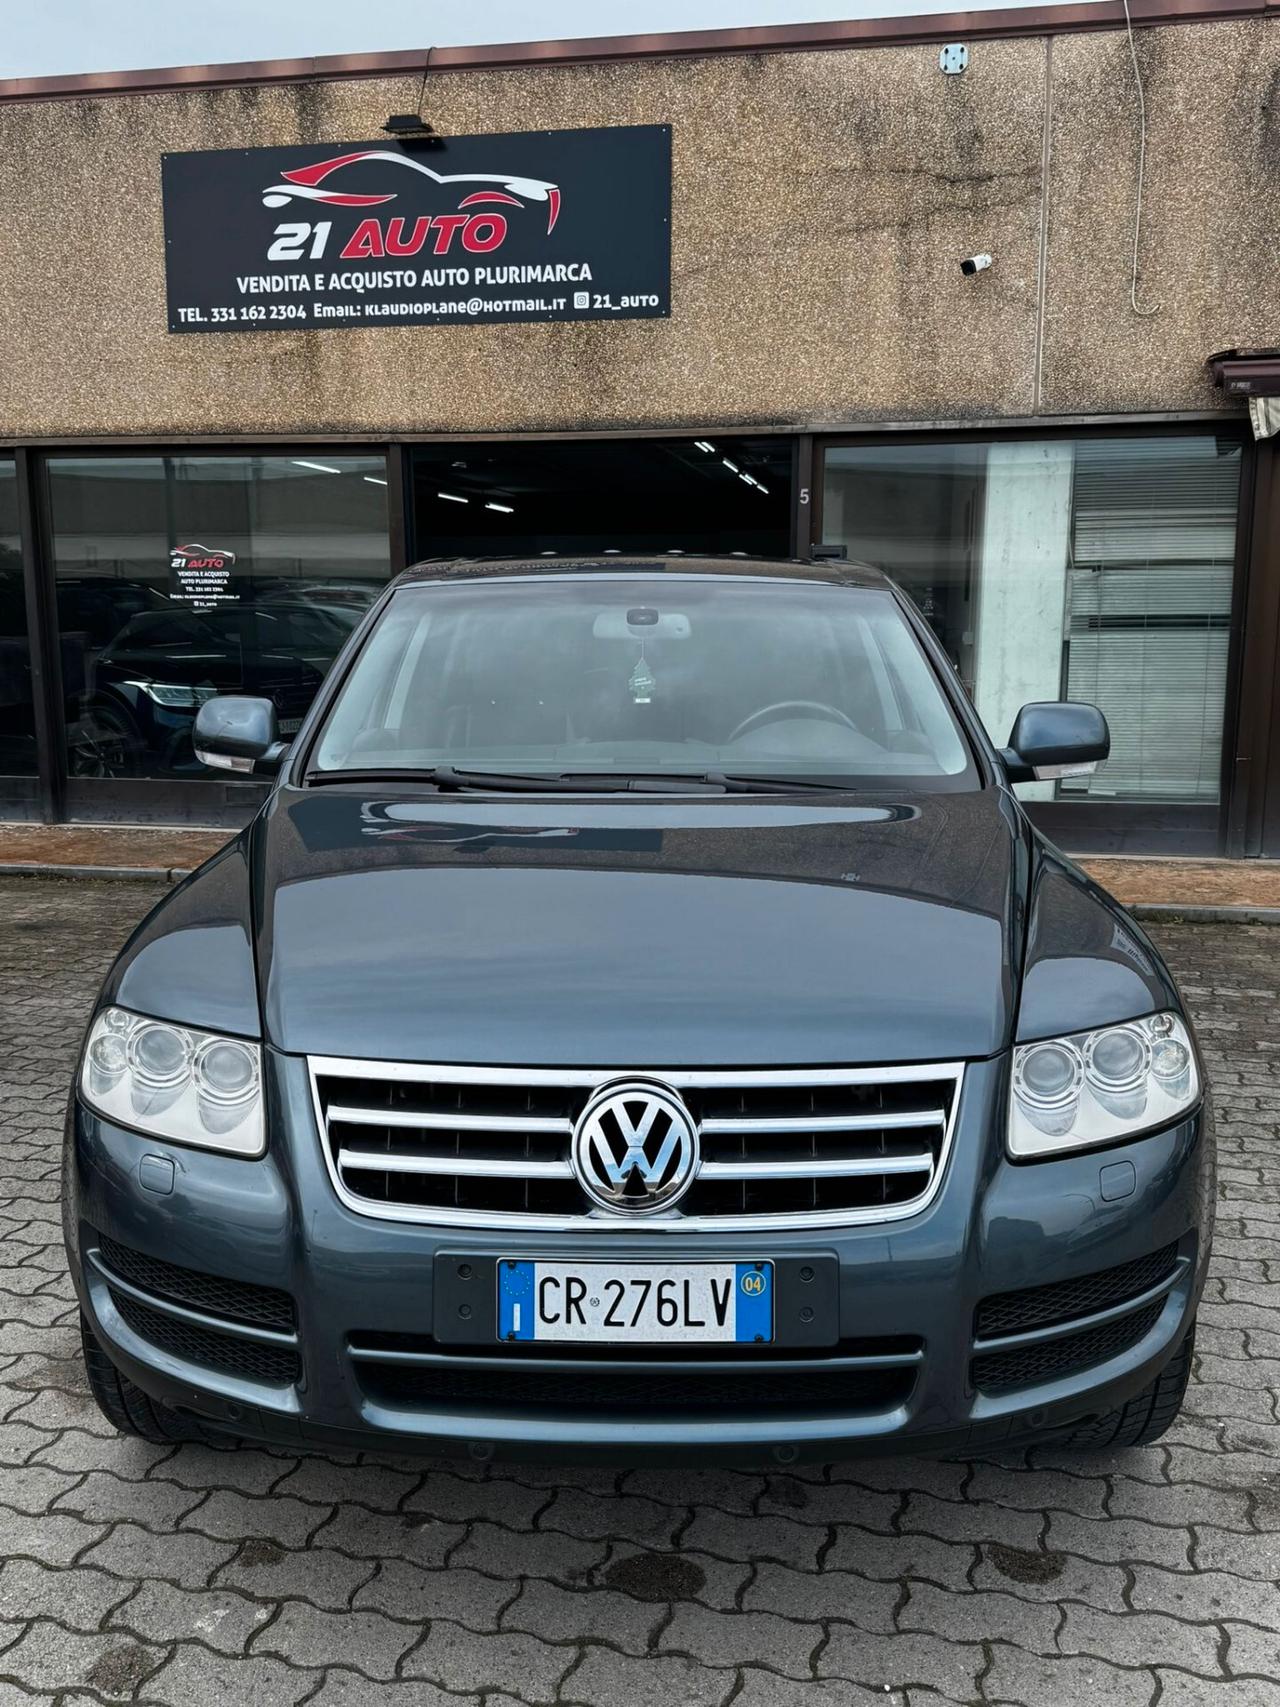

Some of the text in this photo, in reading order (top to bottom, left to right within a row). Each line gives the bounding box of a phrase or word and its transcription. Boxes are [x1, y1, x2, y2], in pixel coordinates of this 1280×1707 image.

[267, 213, 508, 261] 21 AUTO
[236, 263, 593, 293] VENDITA E ACQUISTO AUTO PLURIMARCA
[178, 307, 208, 323] TEL.
[210, 307, 237, 322] 331
[240, 306, 266, 320] 162
[269, 304, 306, 320] 2304
[800, 488, 809, 504] 5
[171, 558, 224, 568] 21 AUTO
[745, 1276, 761, 1292] 04
[539, 1276, 732, 1328] CR 276LV
